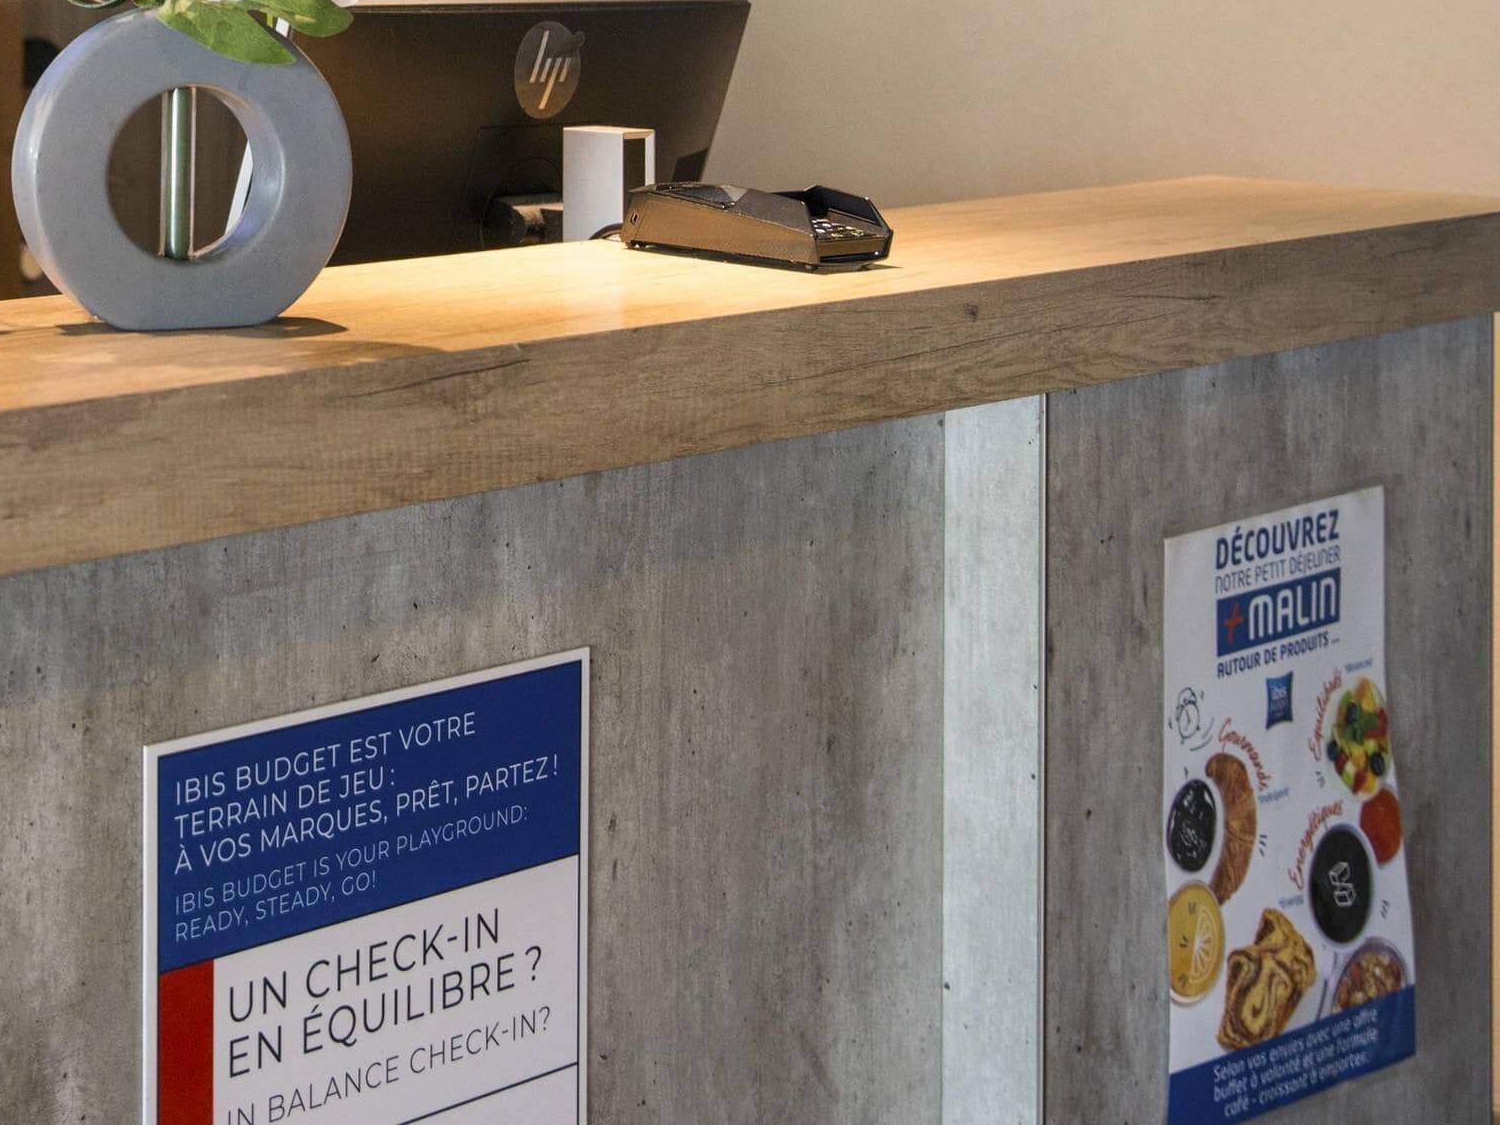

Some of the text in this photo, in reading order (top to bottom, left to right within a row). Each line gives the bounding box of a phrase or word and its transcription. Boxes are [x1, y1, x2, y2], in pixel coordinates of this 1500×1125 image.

[529, 29, 573, 110] hp
[1214, 508, 1341, 571] DÉCOUVREZ
[1255, 557, 1286, 585] PETIT
[1248, 575, 1337, 642] MALIN
[1216, 631, 1329, 679] AUTOUR DE PRODUITS
[174, 711, 478, 807] IBIS BUDGET EST VOTRE
[173, 791, 289, 841] TERRAIN
[297, 778, 332, 812] DE
[339, 772, 385, 799] JEU
[173, 842, 193, 876] À
[201, 831, 253, 869] VOS
[260, 803, 389, 854] MARQUES,
[396, 779, 460, 817] PRÊT,
[174, 804, 530, 916] IBIS BUDGET IS YOUR PLAYGROUND:
[174, 869, 378, 943] READY, STEADY, GO!
[228, 907, 501, 1023] UN CHECK-IN
[228, 1024, 283, 1078] EN
[302, 946, 516, 1057] ÉQUILIBRE
[267, 1055, 401, 1124] BALANCE
[408, 1005, 553, 1075] CHECK-IN?
[1212, 1059, 1246, 1083] Selon
[1248, 1051, 1267, 1069] vos
[1269, 1038, 1304, 1063] envies
[1306, 1027, 1332, 1047] avec
[1213, 1075, 1249, 1103] buffet
